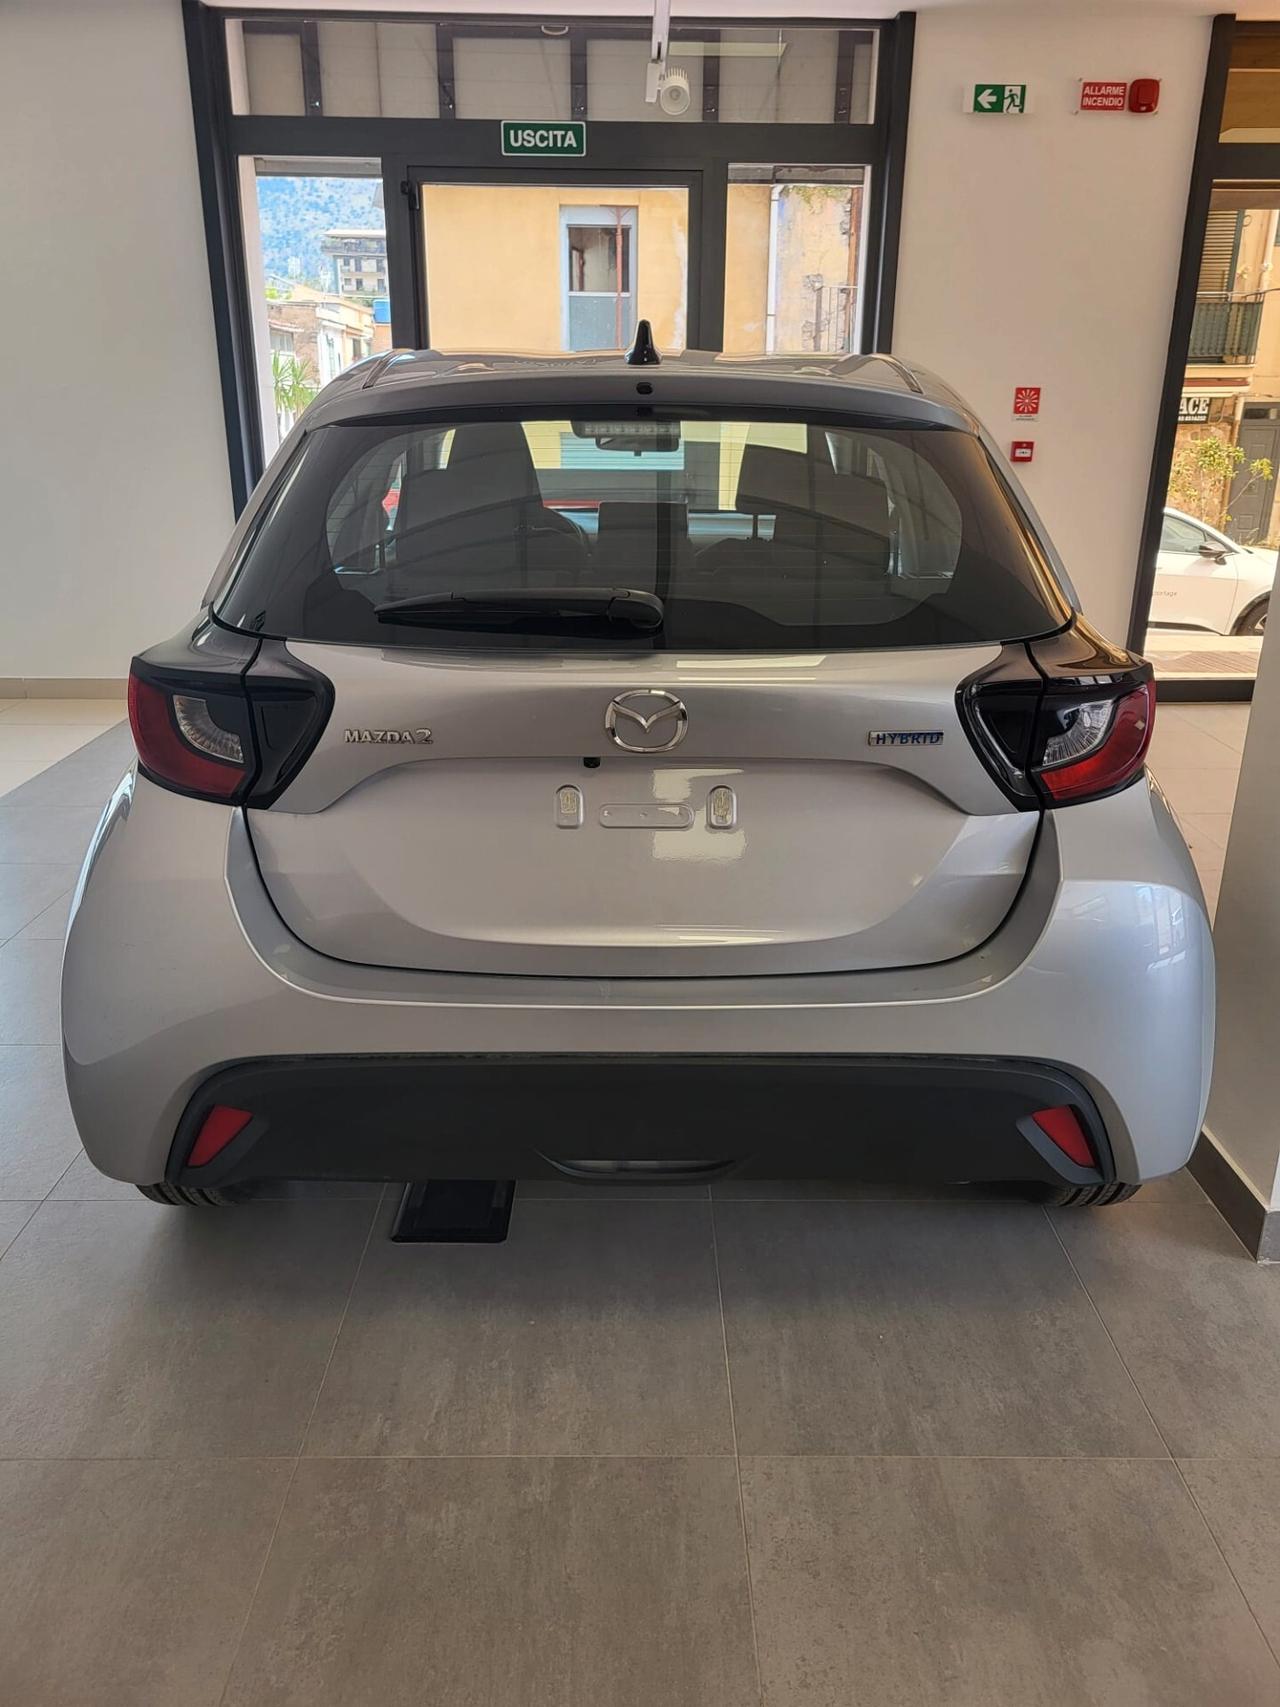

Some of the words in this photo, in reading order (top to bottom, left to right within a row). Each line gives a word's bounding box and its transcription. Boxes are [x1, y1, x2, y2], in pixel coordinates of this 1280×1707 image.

[1083, 86, 1125, 96] ALLARME
[1082, 97, 1123, 107] INCENDIO
[509, 129, 577, 148] USCITA
[875, 732, 941, 745] HYBRID
